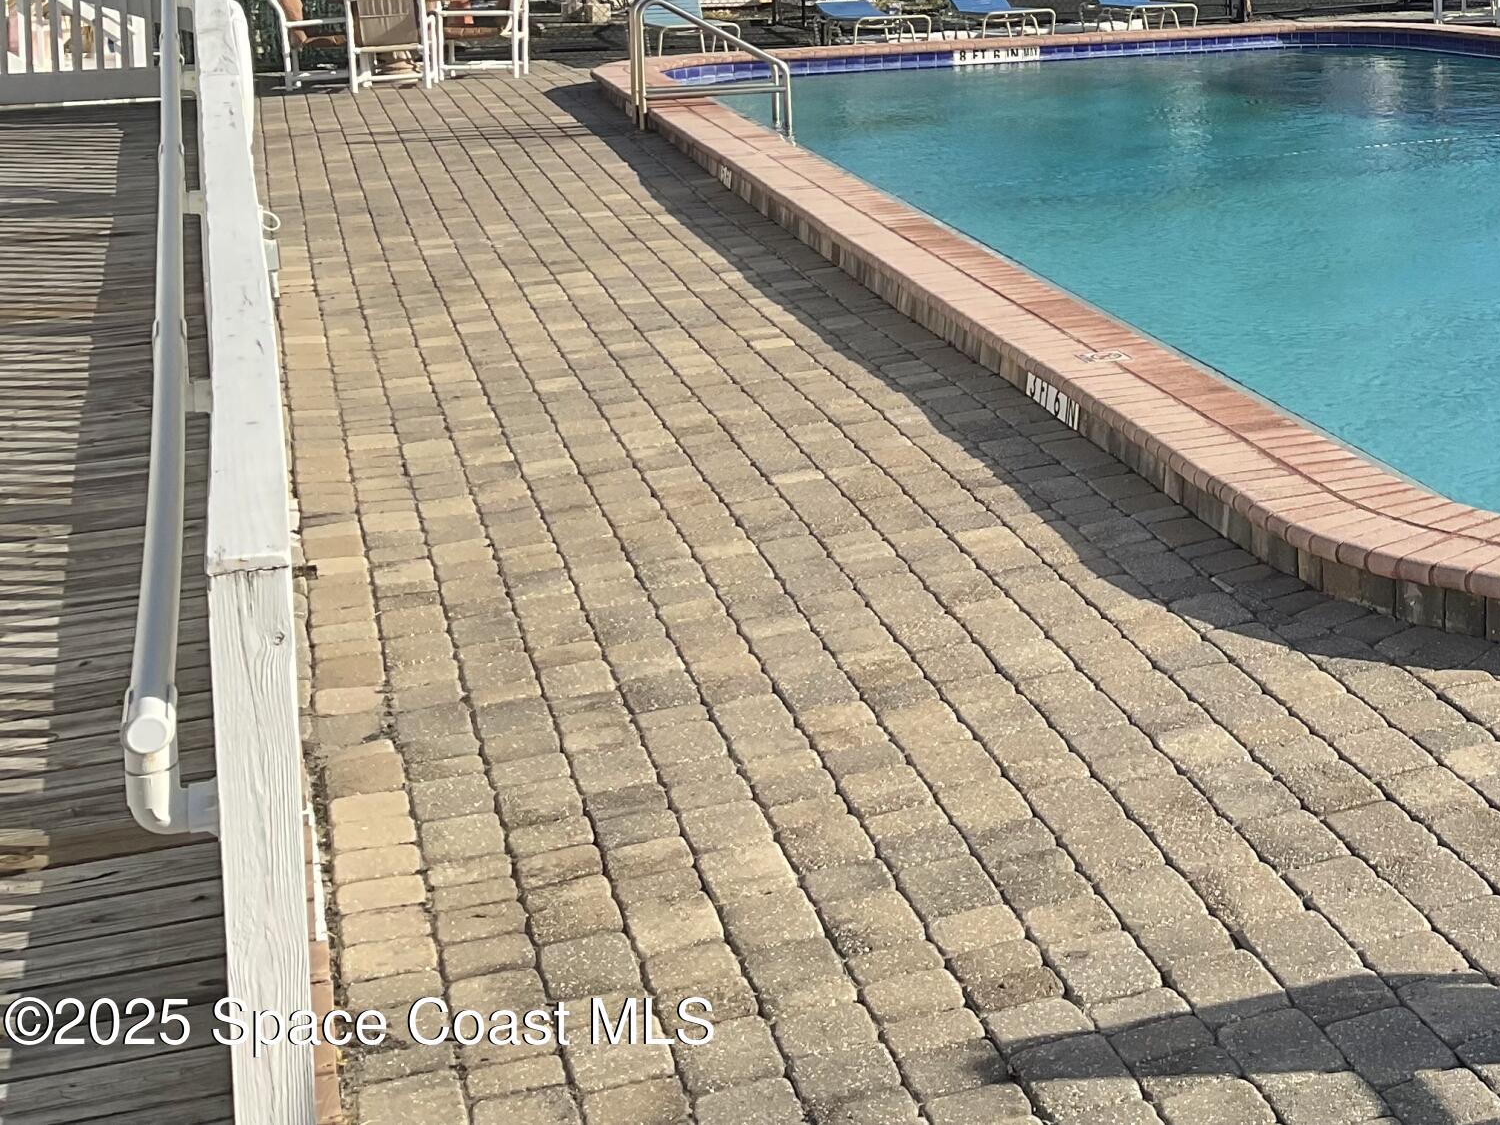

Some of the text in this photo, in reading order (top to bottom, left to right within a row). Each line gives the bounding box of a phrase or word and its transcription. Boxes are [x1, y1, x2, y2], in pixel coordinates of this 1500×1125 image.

[960, 50, 966, 62] 8
[973, 49, 987, 60] FT
[1006, 48, 1019, 58] IN
[1054, 390, 1060, 417] 6
[1065, 396, 1077, 429] IN
